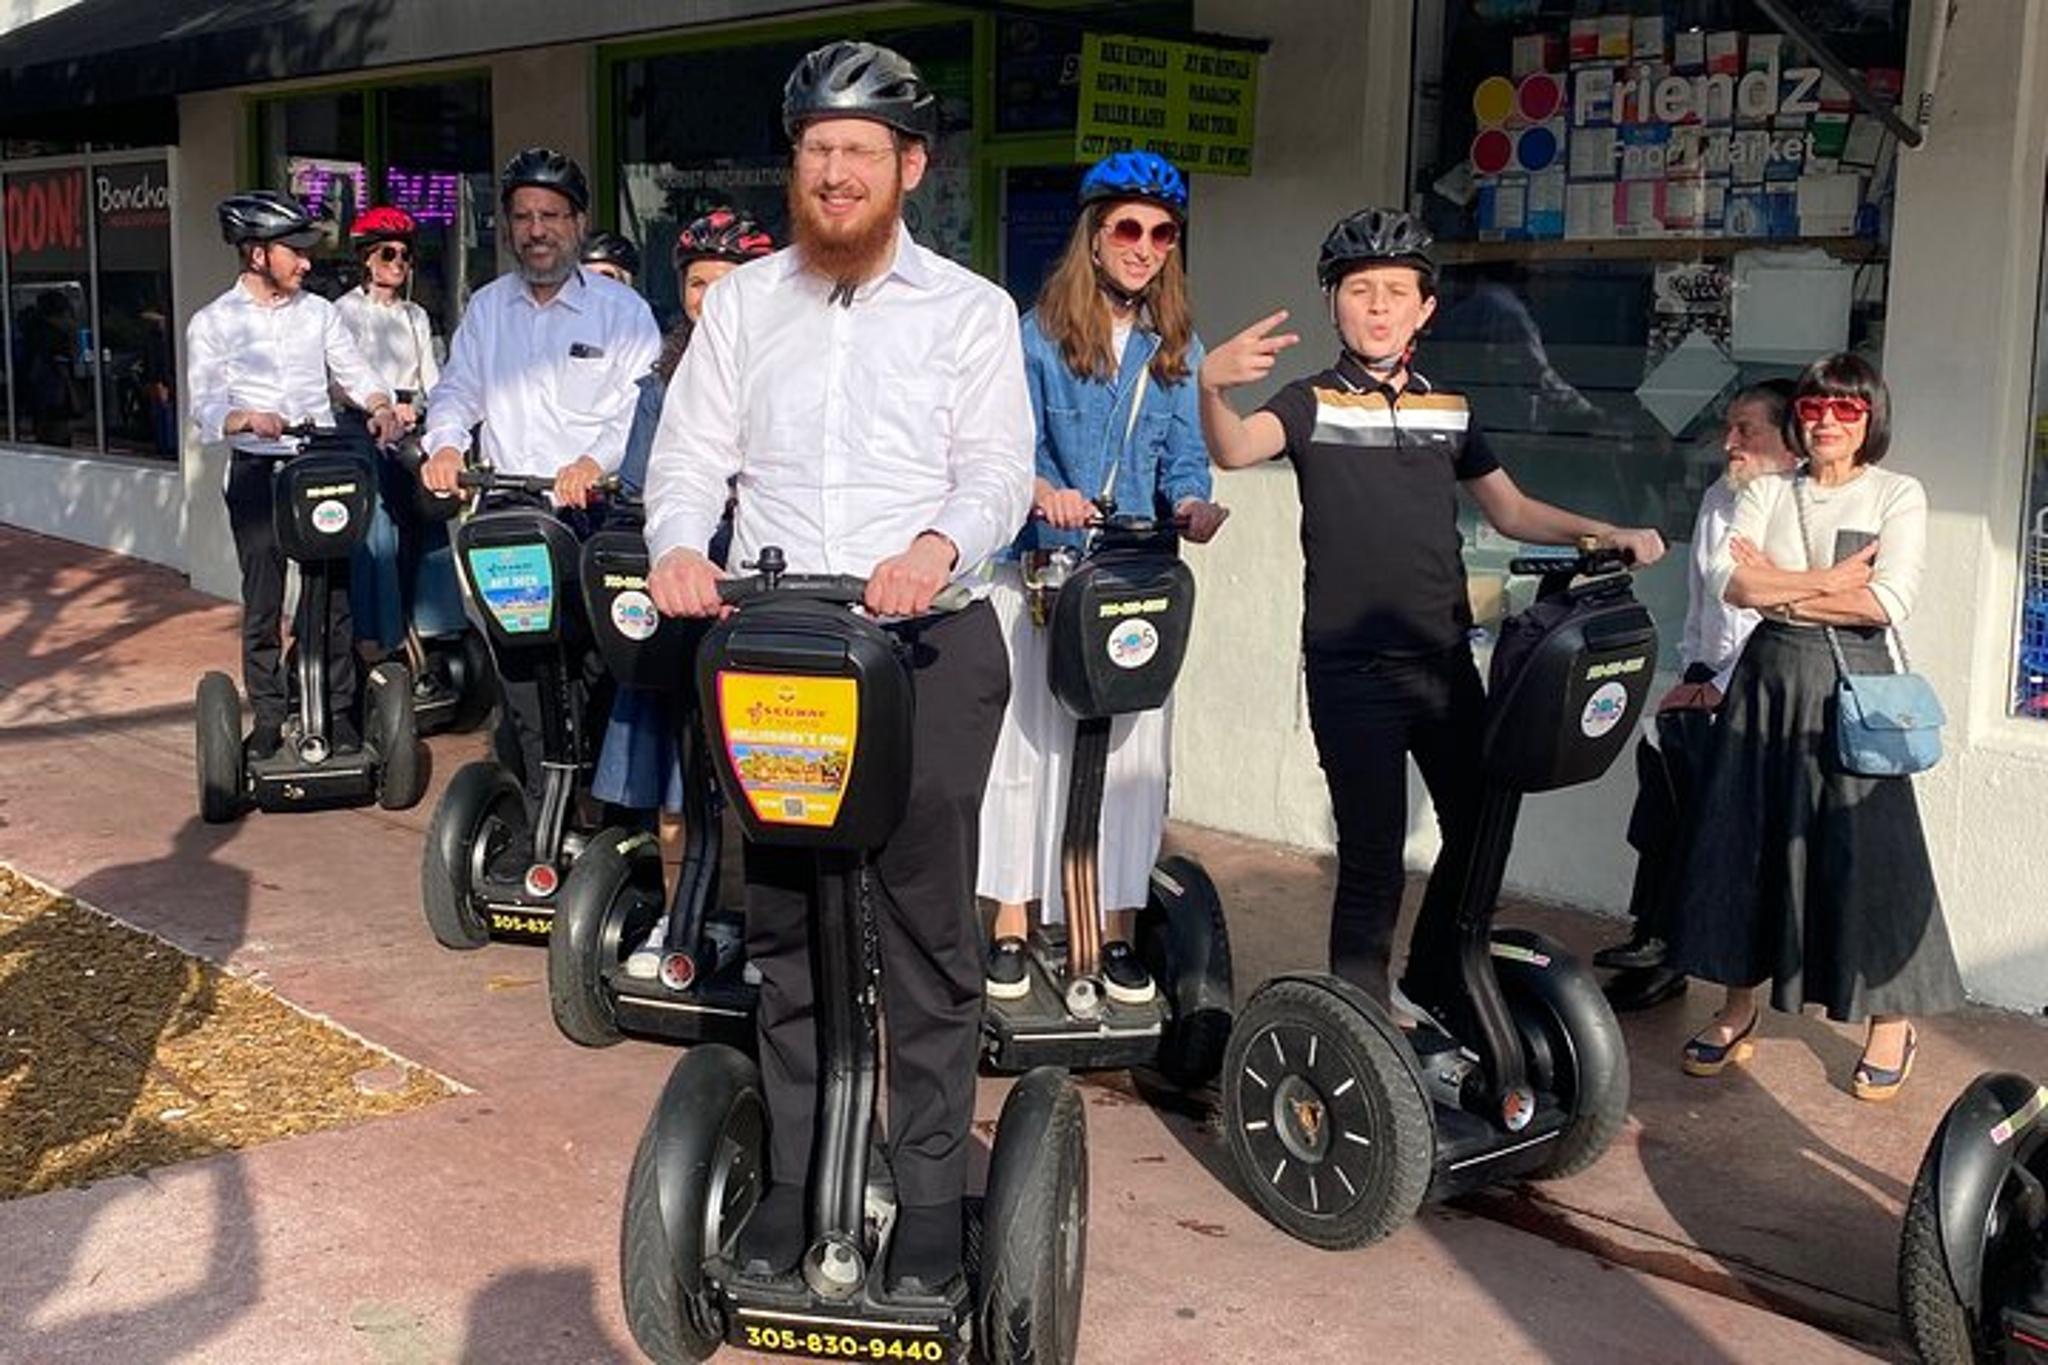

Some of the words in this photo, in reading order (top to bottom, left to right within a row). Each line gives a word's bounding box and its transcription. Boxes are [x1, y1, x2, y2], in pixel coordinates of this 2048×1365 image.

[1574, 52, 1822, 127] Friendz
[1608, 133, 1692, 167] Food
[1704, 129, 1817, 164] Market
[97, 172, 169, 213] Boncho
[745, 1324, 943, 1362] 305-830-9440
